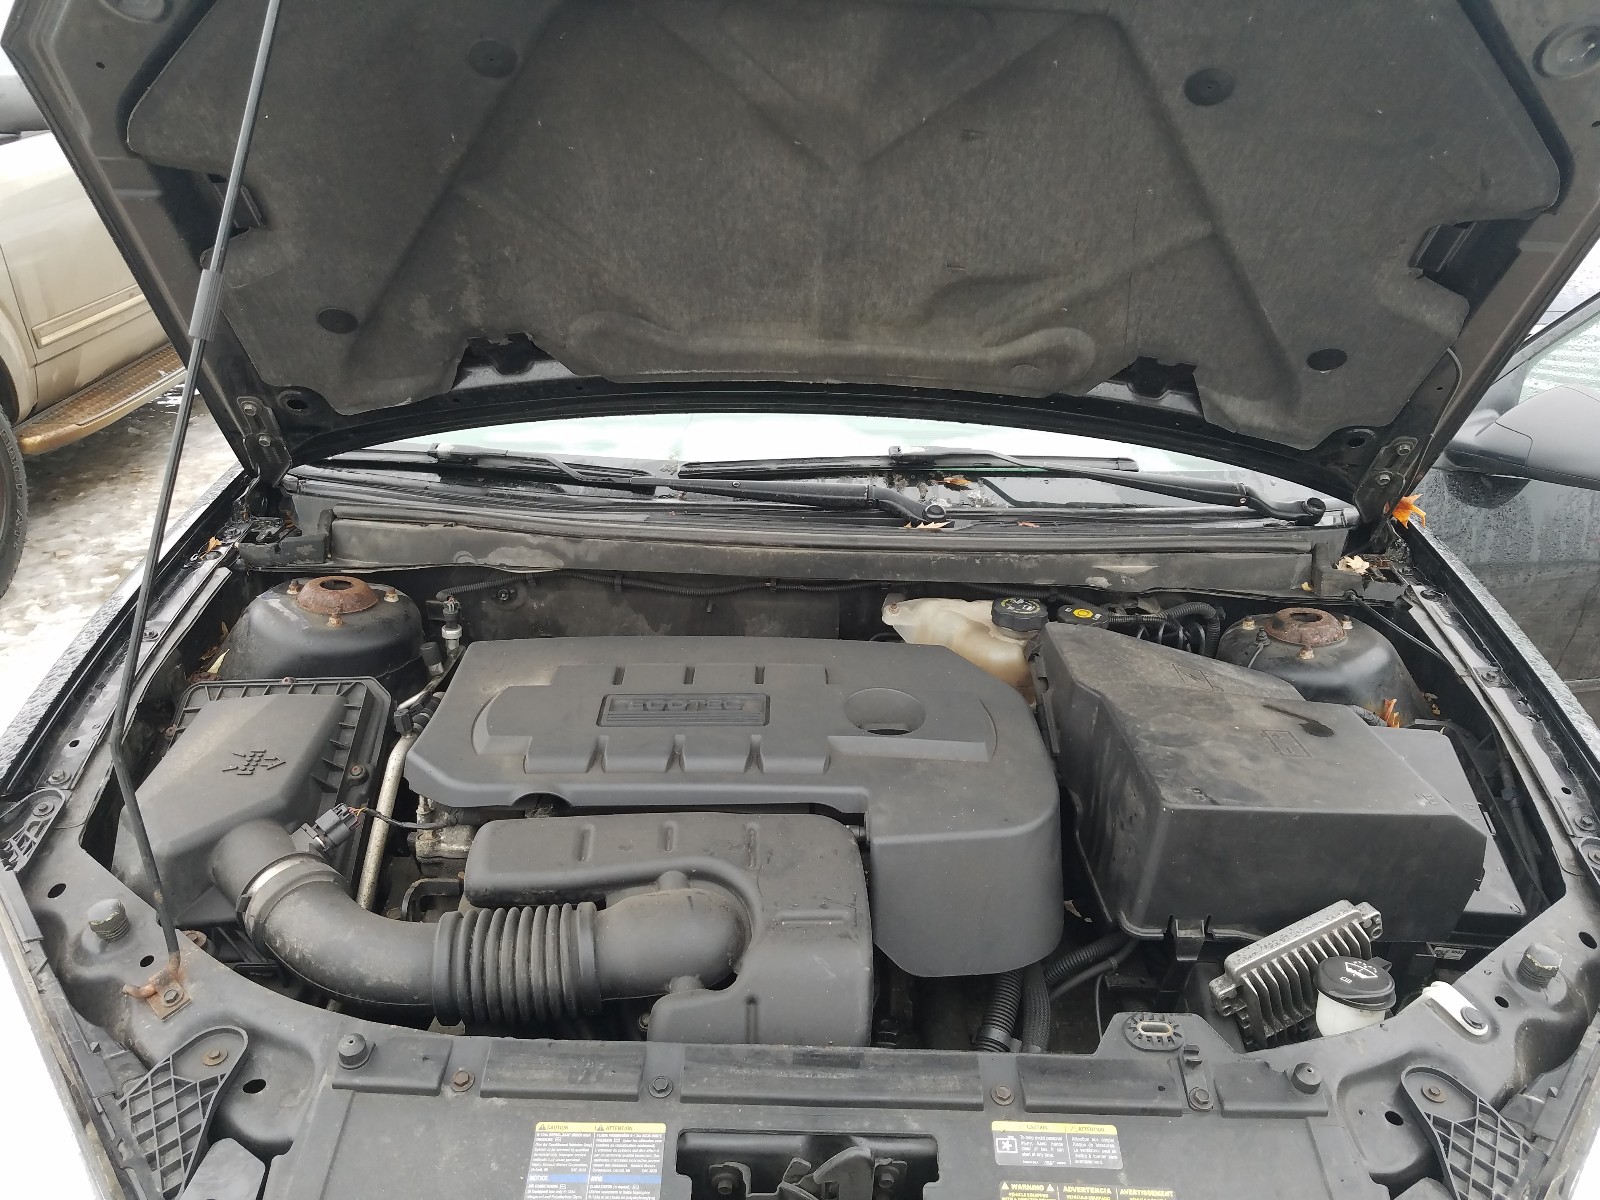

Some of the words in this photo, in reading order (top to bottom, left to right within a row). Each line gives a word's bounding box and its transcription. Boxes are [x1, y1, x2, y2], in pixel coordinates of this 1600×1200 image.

[1010, 1183, 1045, 1191] WARNING
[1062, 1185, 1112, 1195] ADVERTENCIA
[1119, 1188, 1174, 1198] AVERTISSEMENT
